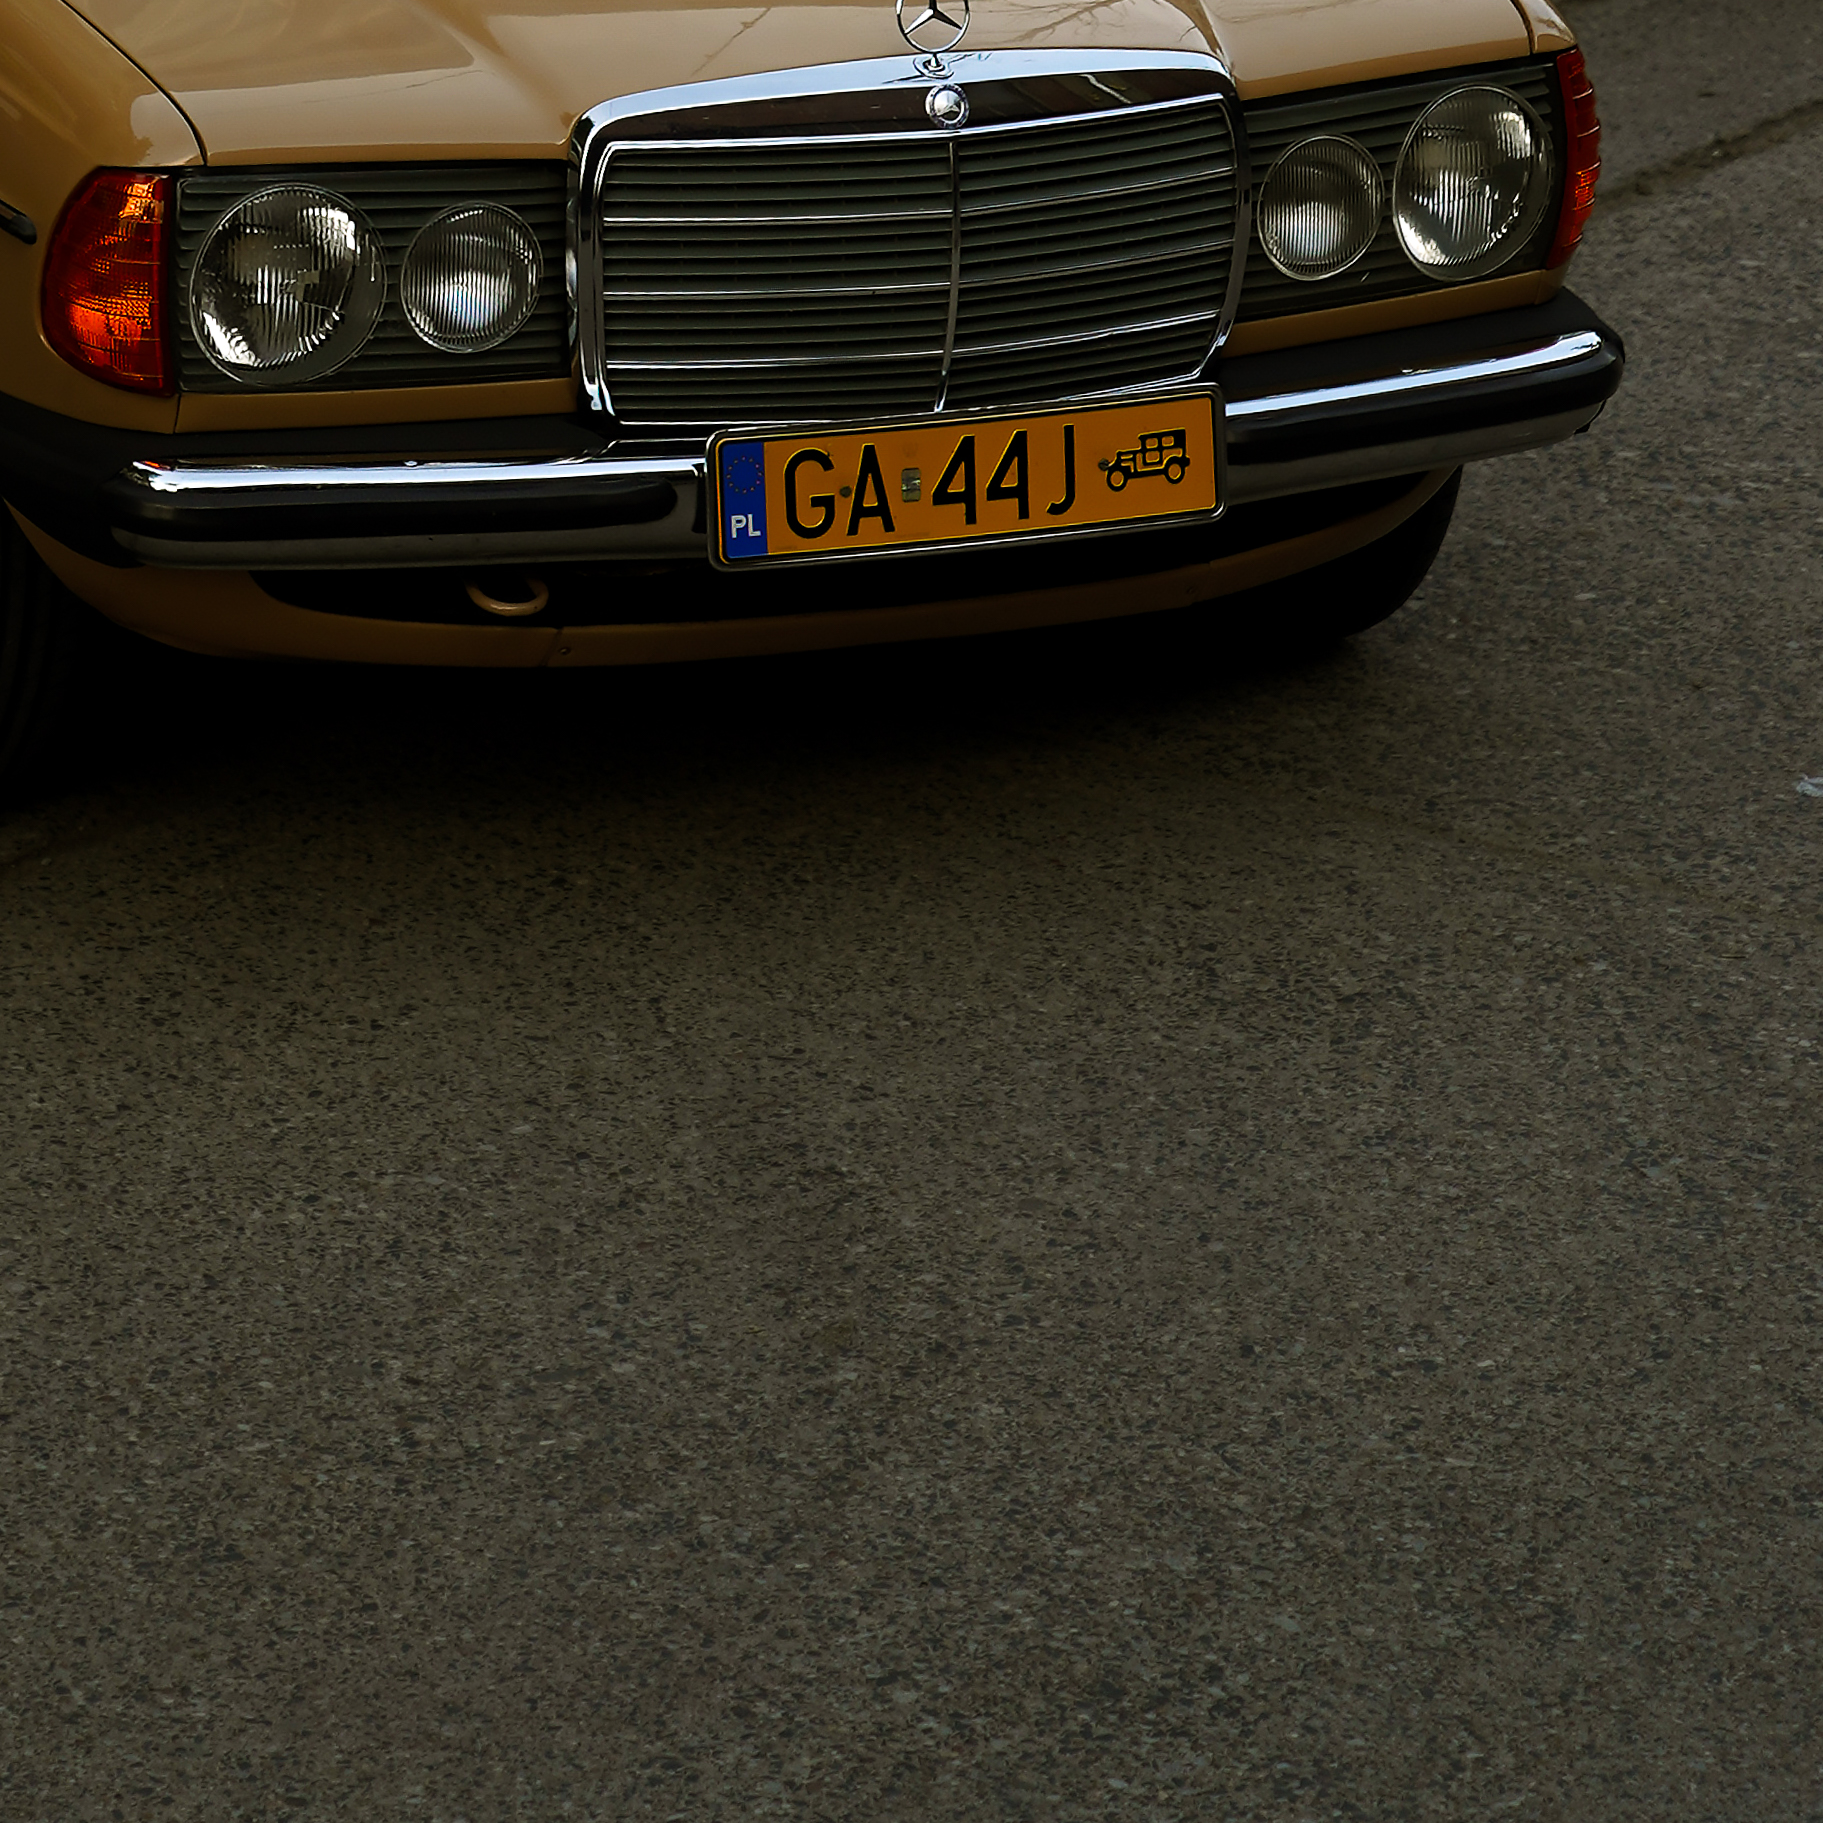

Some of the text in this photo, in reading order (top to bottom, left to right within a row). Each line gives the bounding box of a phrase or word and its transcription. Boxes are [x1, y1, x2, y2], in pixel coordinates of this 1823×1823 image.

[784, 424, 1077, 539] GA 44J
[730, 514, 762, 539] PL
